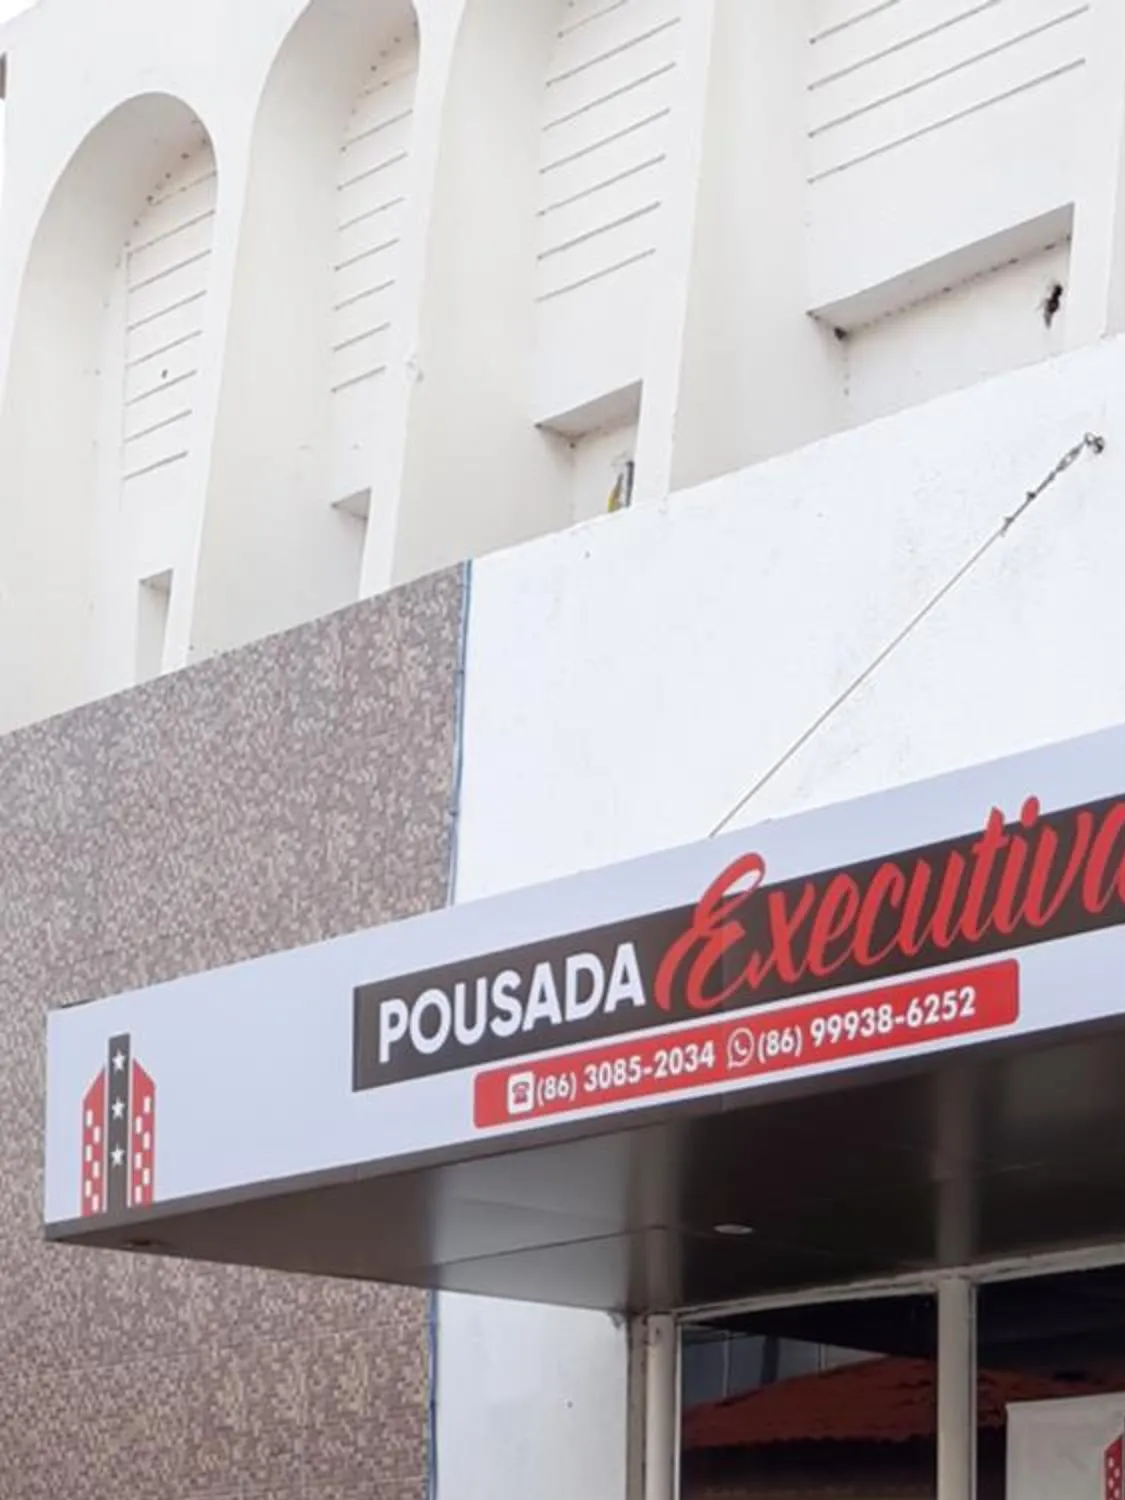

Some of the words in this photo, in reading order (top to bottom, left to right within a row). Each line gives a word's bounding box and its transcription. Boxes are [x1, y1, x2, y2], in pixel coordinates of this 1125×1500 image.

[379, 942, 646, 1064] POUSADA
[537, 1071, 577, 1107] (86)
[583, 1040, 716, 1092] 3085-2034
[758, 1026, 802, 1063] (86)
[810, 986, 977, 1048] 99938-6252
